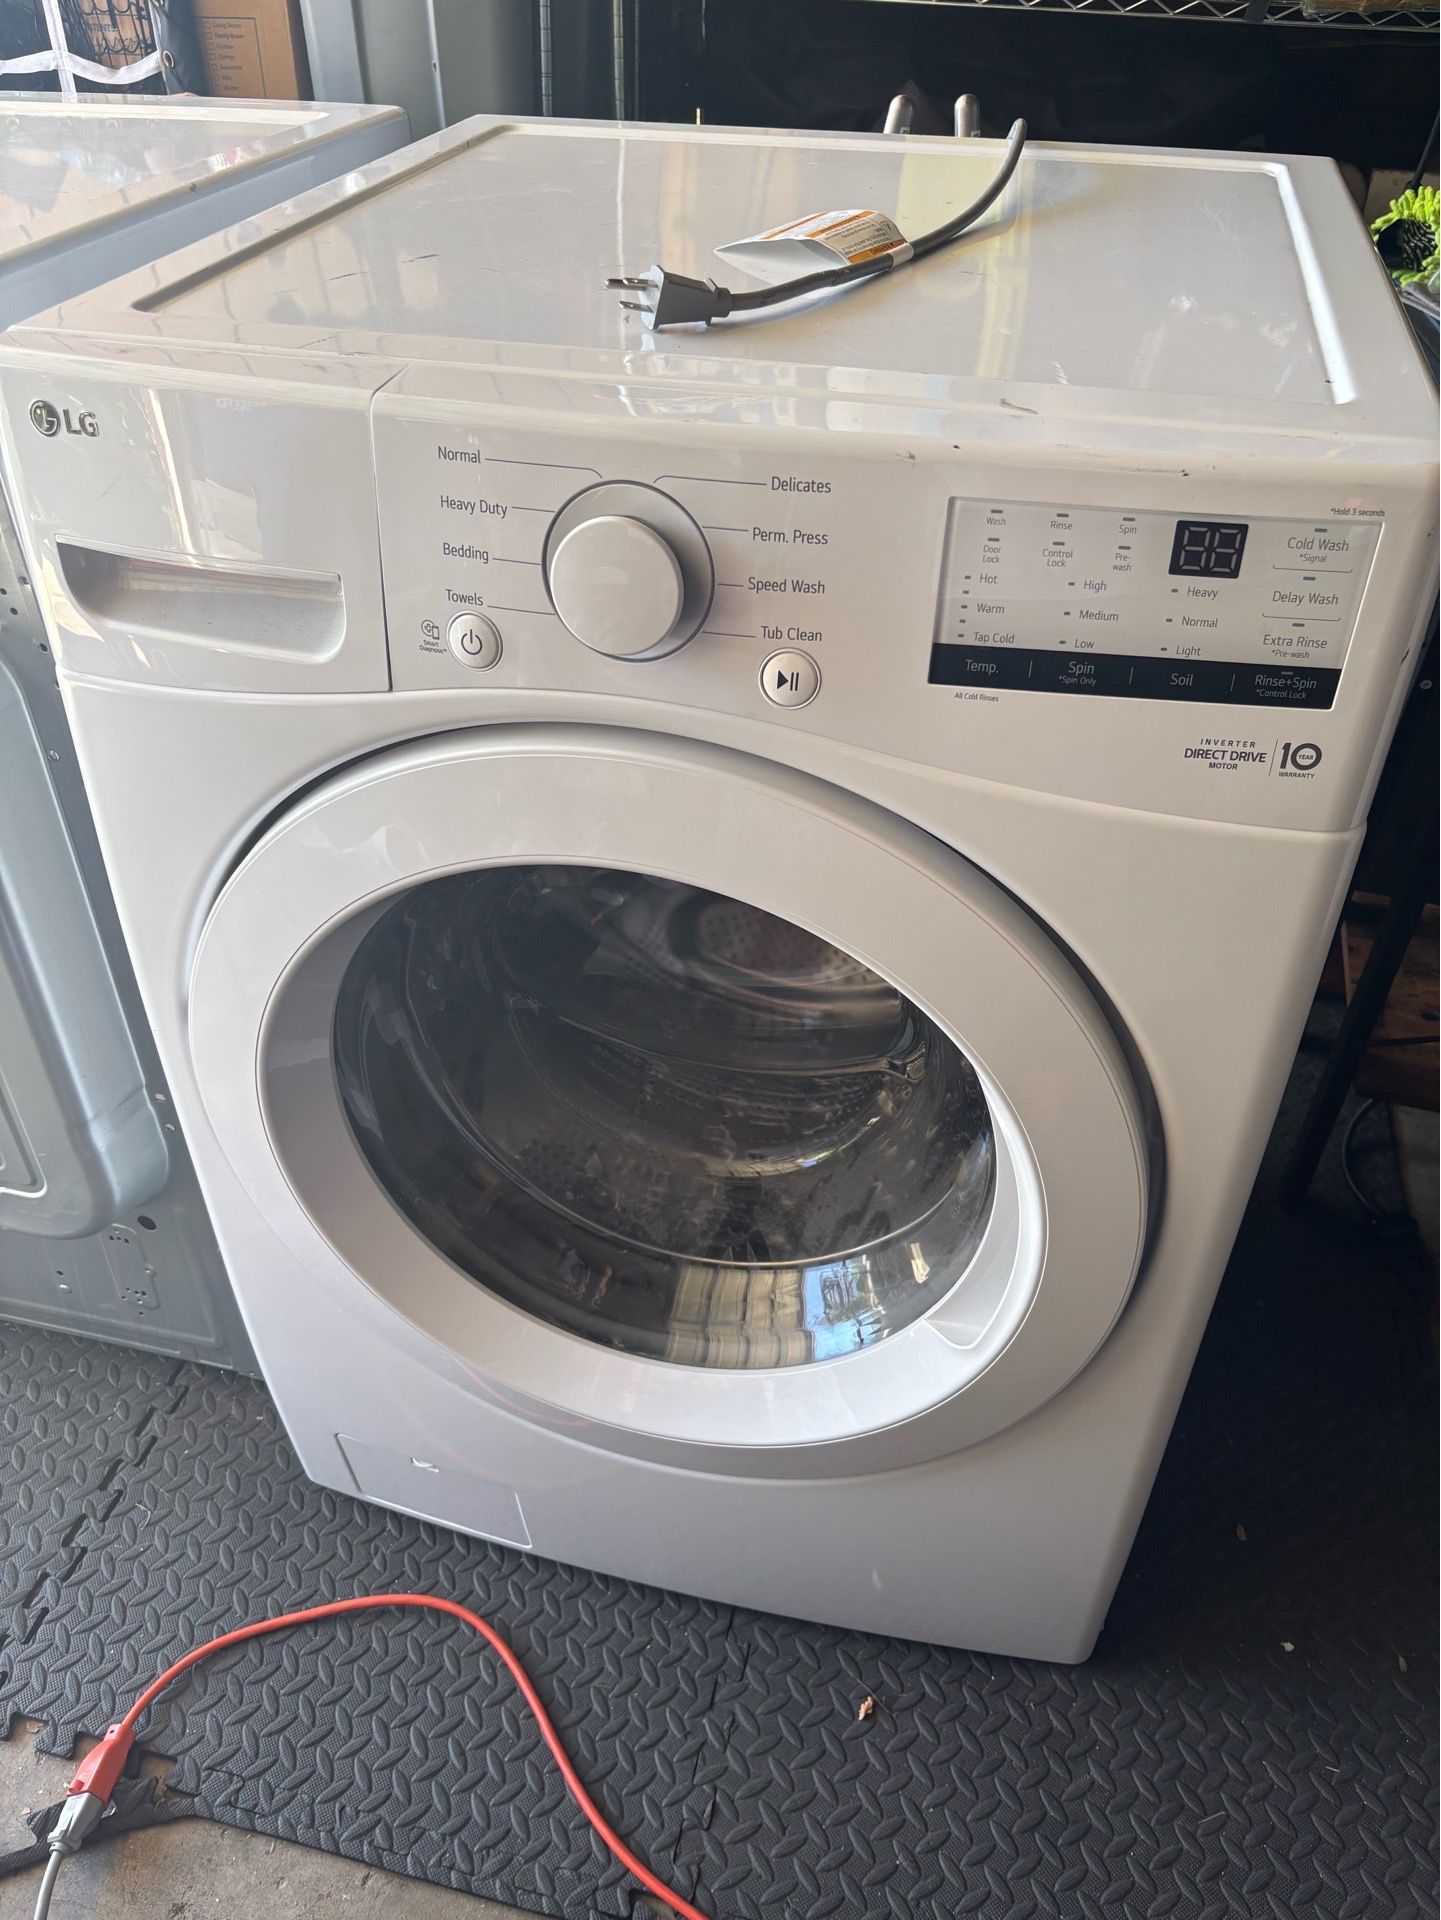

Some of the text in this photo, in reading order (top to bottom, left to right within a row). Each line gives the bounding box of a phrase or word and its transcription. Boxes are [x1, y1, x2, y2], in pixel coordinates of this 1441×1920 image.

[62, 408, 100, 437] LG
[438, 446, 481, 464] Normal
[771, 476, 831, 493] Delicates
[440, 495, 508, 519] Heavy Duty
[1358, 508, 1386, 517] seconds
[986, 517, 1006, 526] Wash
[1050, 520, 1073, 530] Rinse
[1118, 524, 1137, 534] Spin
[752, 527, 829, 545] Perm. Press
[983, 545, 1002, 554] Door
[1287, 536, 1350, 552] Cold Wash
[443, 542, 489, 564] Bedding
[982, 554, 1000, 564] Lock
[1042, 548, 1073, 558] Control
[1115, 552, 1131, 562] Pre-
[1046, 558, 1066, 568] Lock
[1112, 562, 1132, 572] wash
[748, 576, 825, 594] Speed Wash
[979, 574, 998, 584] Hot
[1083, 580, 1107, 593] High
[445, 588, 484, 606] Towels
[1186, 586, 1219, 600] Heavy
[1272, 590, 1339, 606] Delay Wash
[976, 603, 1005, 614] Warm
[1079, 610, 1120, 622] Medium
[1181, 616, 1219, 628] Normal
[761, 626, 822, 642] Tub Clean
[974, 632, 1015, 644] Tap Cold
[1074, 638, 1095, 649] Low
[1263, 634, 1328, 648] Extra Rinse
[1176, 645, 1202, 658] Light
[965, 659, 1000, 676] Temp.
[1068, 661, 1096, 676] Spin
[1080, 676, 1097, 686] Only
[1170, 673, 1194, 686] Soil
[1254, 674, 1317, 690] Rinse+Spin
[954, 692, 1000, 702] All Cold Rinses
[1289, 690, 1308, 700] Lock
[1200, 738, 1256, 748] INVERTER
[1184, 748, 1268, 763] DIRECT DRIVE
[1280, 742, 1322, 770] 10
[1208, 762, 1238, 770] MOTOR
[1278, 771, 1315, 779] WARRANTY
